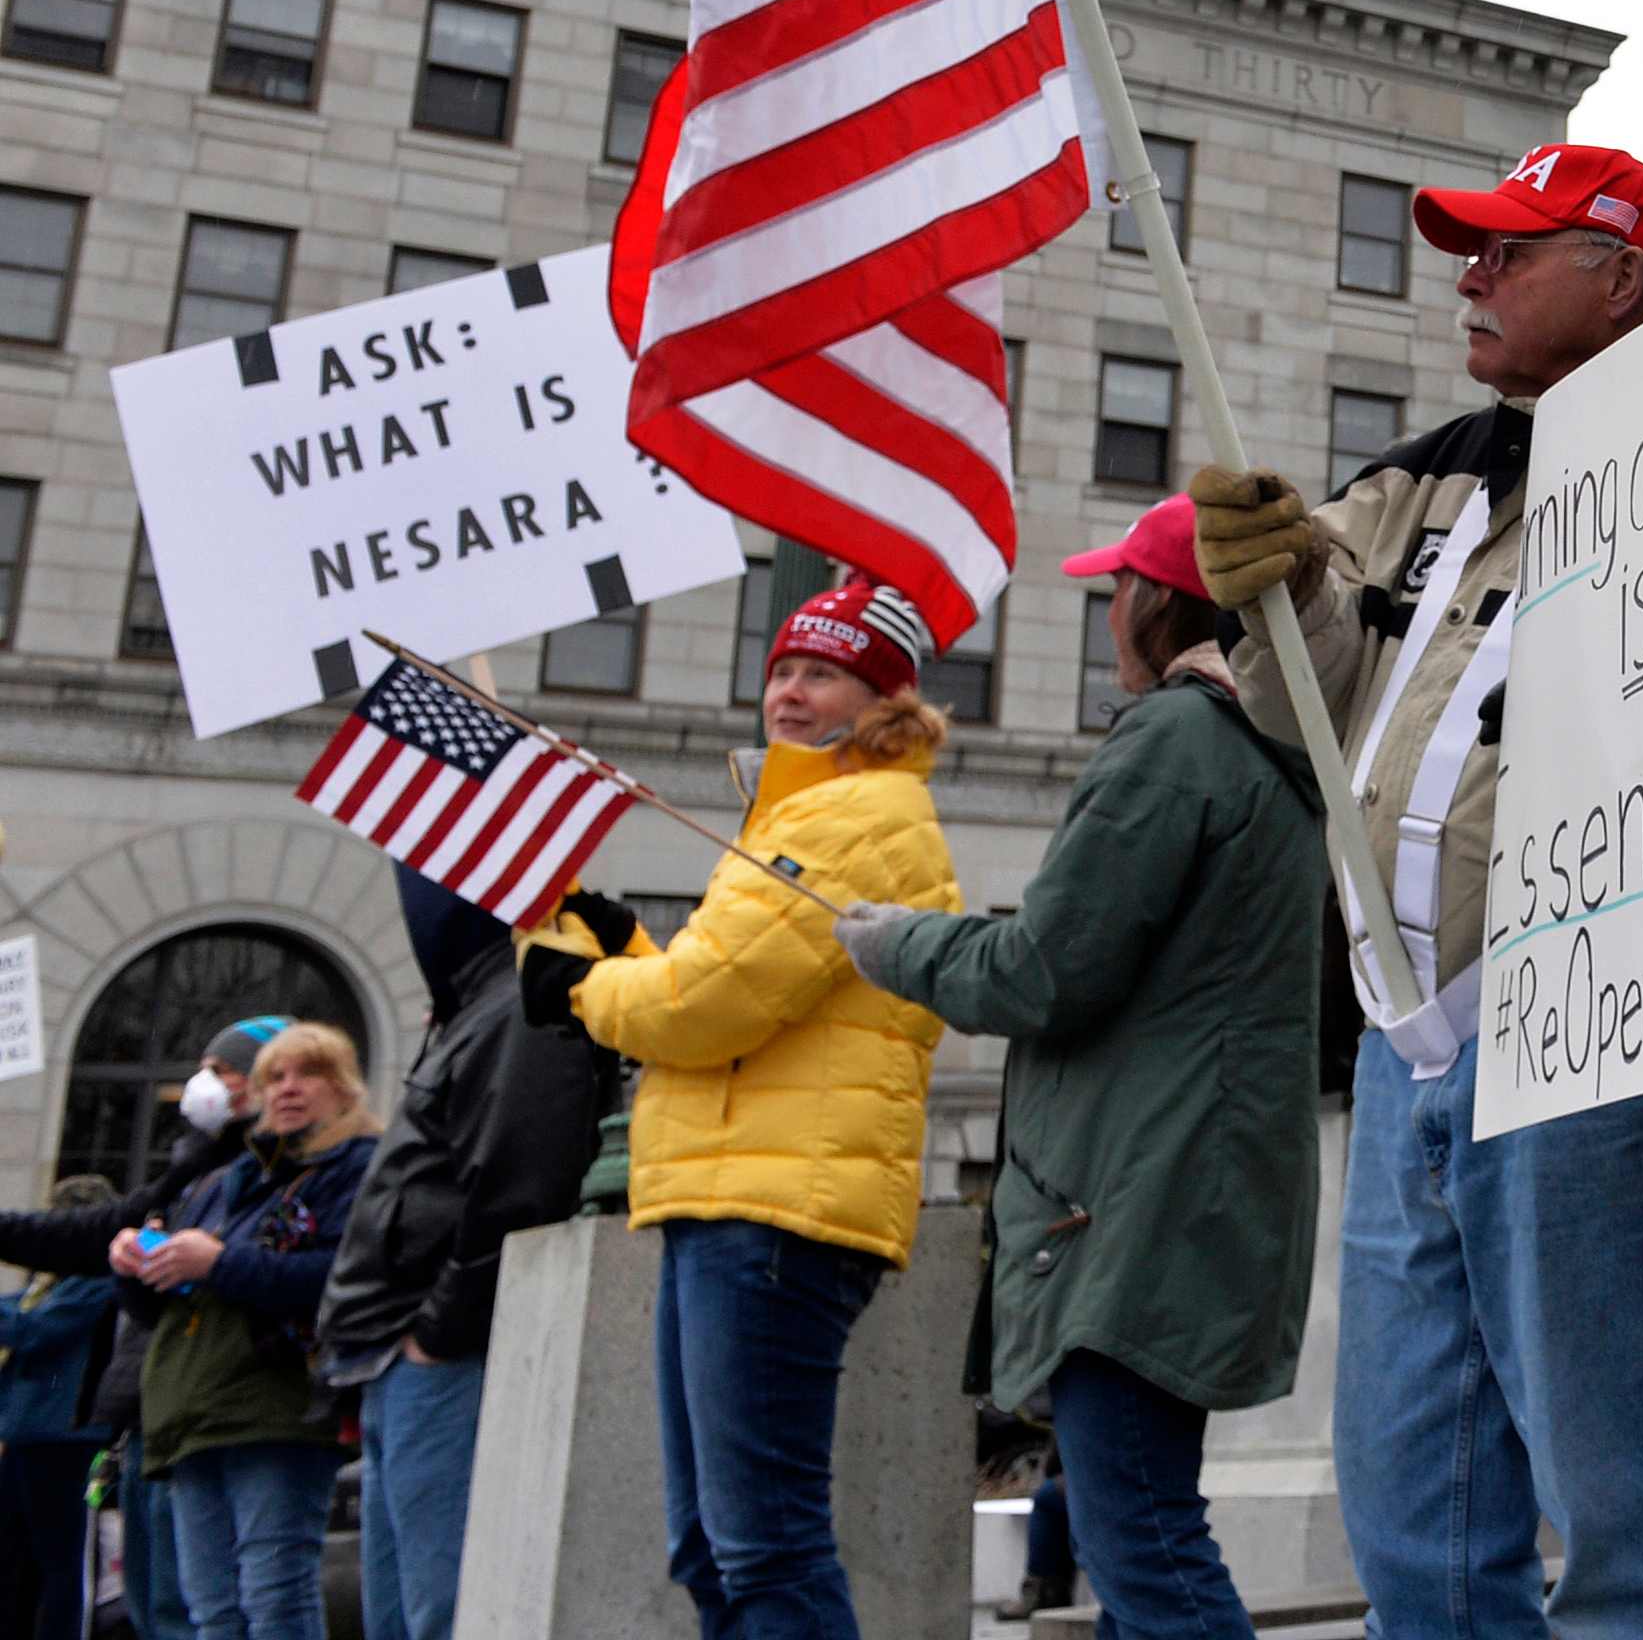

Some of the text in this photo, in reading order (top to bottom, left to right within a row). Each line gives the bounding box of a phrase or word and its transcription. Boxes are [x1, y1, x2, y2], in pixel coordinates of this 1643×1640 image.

[1193, 42, 1384, 116] THIRTY
[318, 319, 477, 397] ASK:
[249, 375, 577, 498] WHAT IS
[309, 478, 604, 599] NESARA
